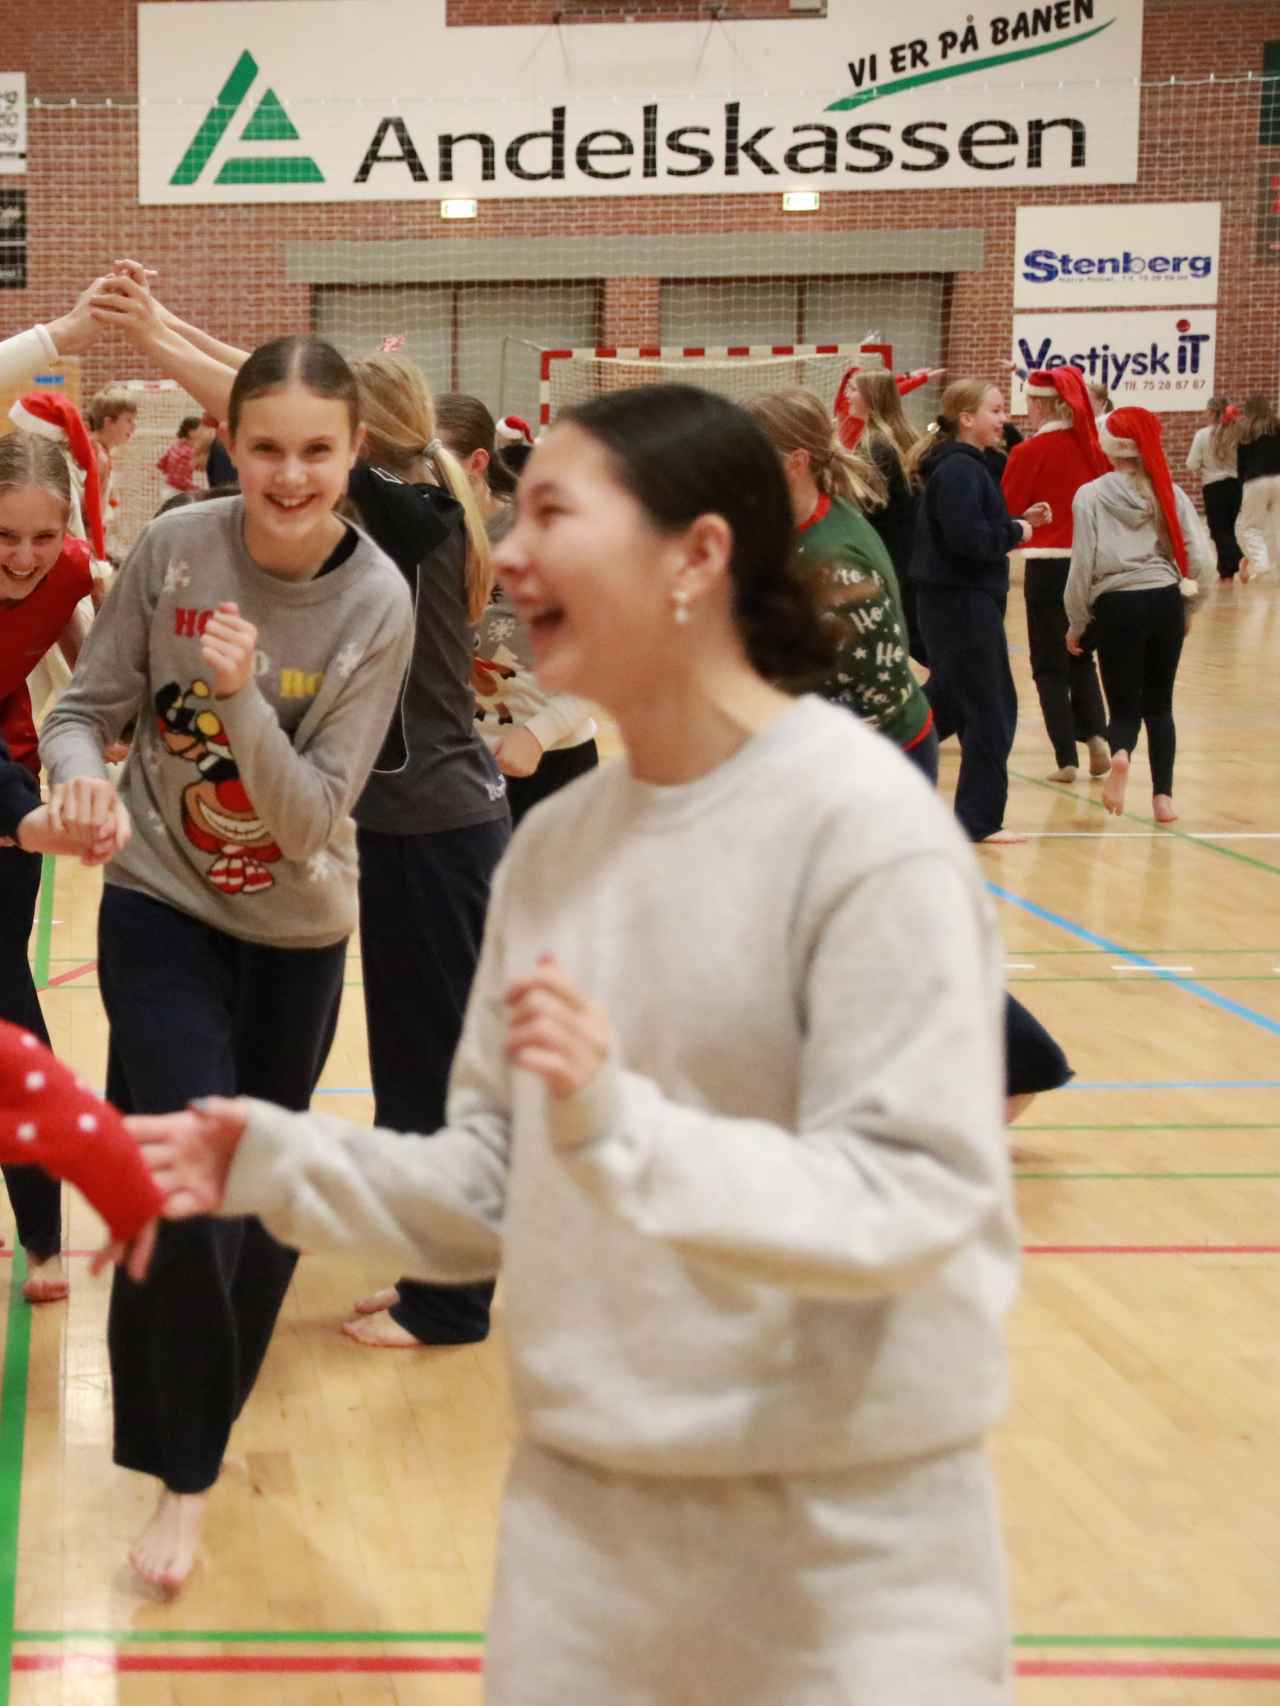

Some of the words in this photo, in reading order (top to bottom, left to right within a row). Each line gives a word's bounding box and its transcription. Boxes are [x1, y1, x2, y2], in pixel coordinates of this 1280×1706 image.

[848, 54, 877, 87] VI
[889, 40, 929, 73] ER
[938, 14, 979, 59] PÅ
[990, 0, 1095, 45] BANEN
[353, 103, 1086, 183] Andelskassen
[1022, 249, 1212, 284] Stenberg
[1017, 337, 1171, 391] Vestjysk
